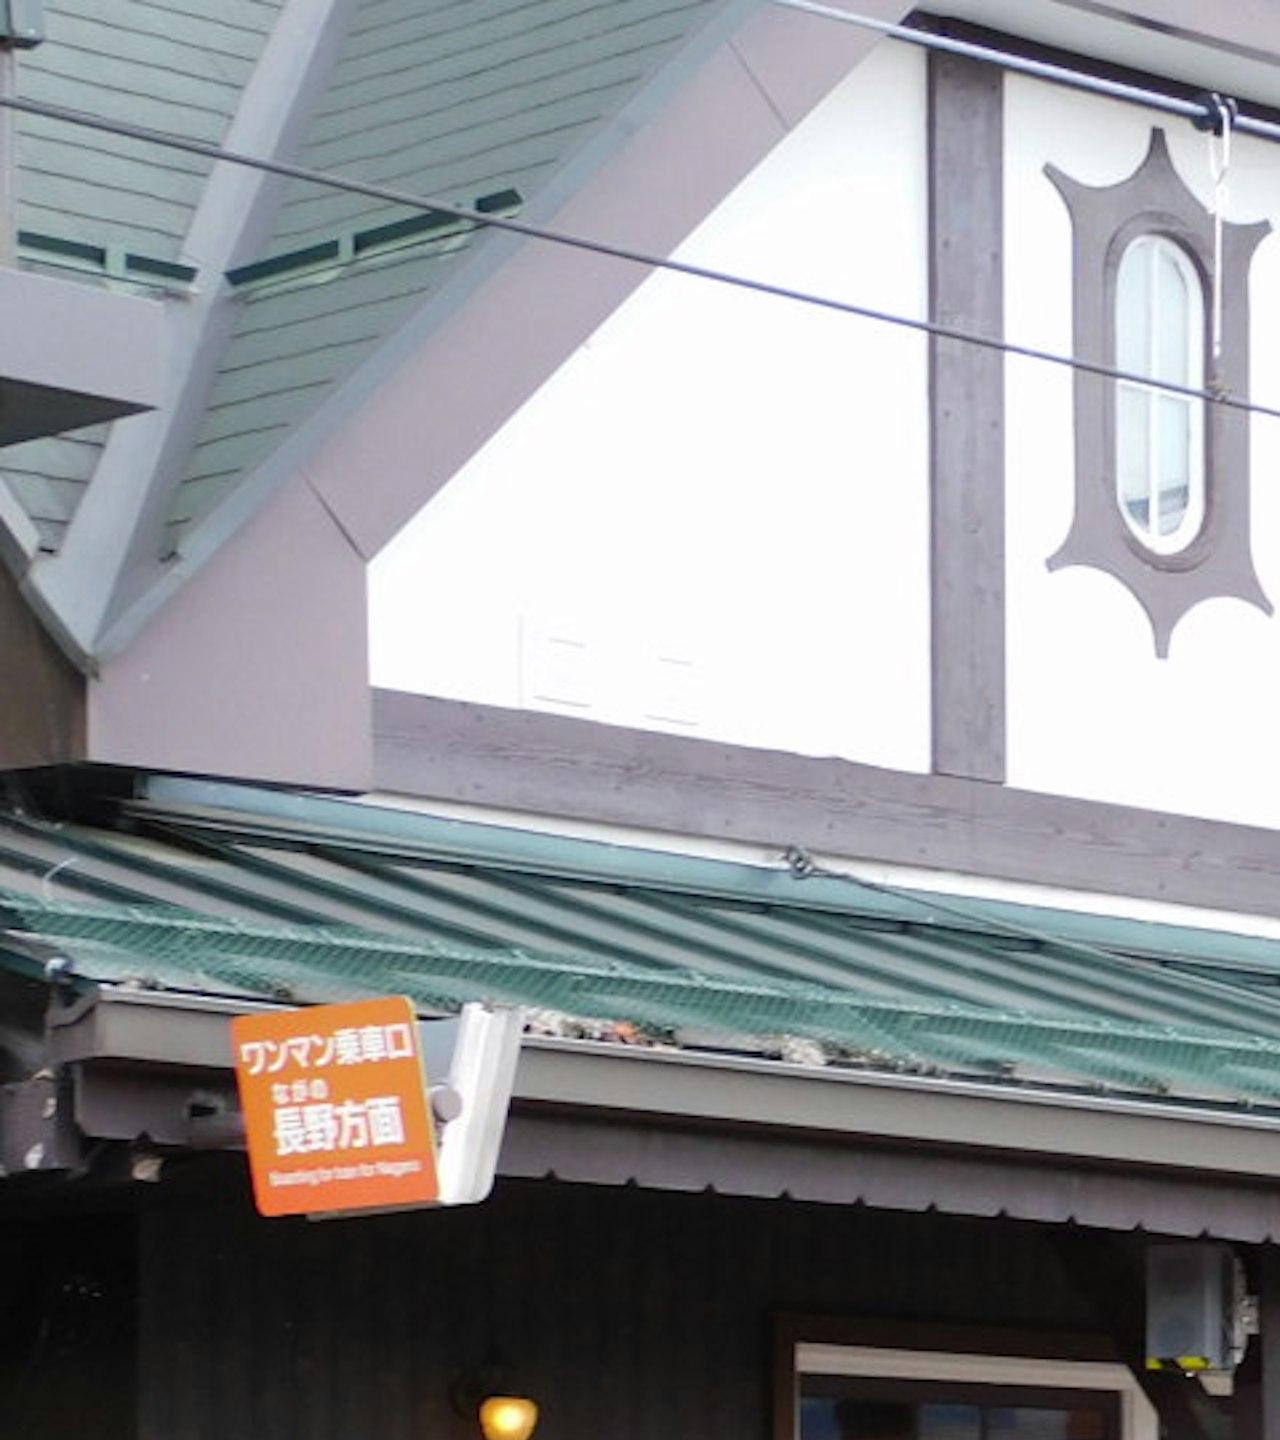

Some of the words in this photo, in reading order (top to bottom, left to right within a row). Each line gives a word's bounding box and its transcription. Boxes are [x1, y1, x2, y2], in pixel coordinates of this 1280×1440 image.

[239, 1022, 415, 1076] ワンマン乗車口
[273, 1095, 406, 1156] 長野方面
